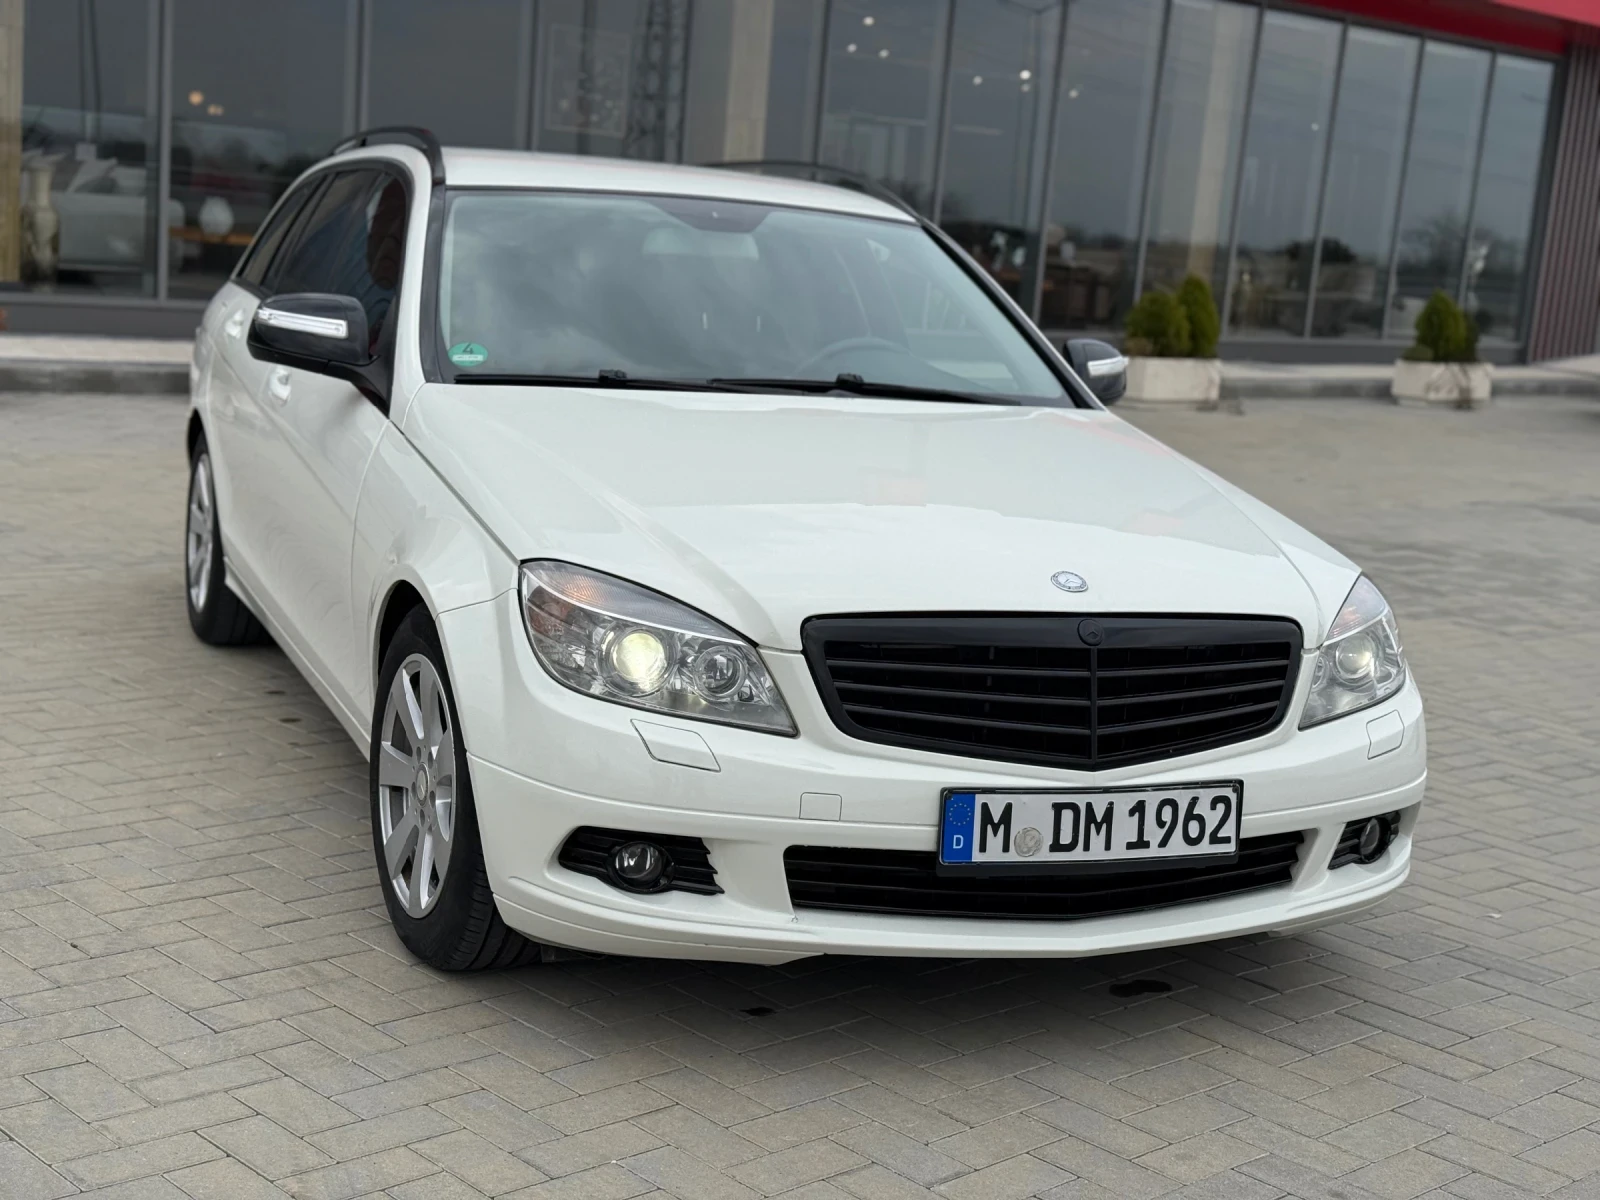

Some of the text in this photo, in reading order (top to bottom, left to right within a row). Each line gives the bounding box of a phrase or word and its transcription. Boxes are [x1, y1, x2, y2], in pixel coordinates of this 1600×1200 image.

[462, 342, 474, 354] 4
[978, 795, 1232, 853] M DM 1962
[953, 834, 964, 849] D
